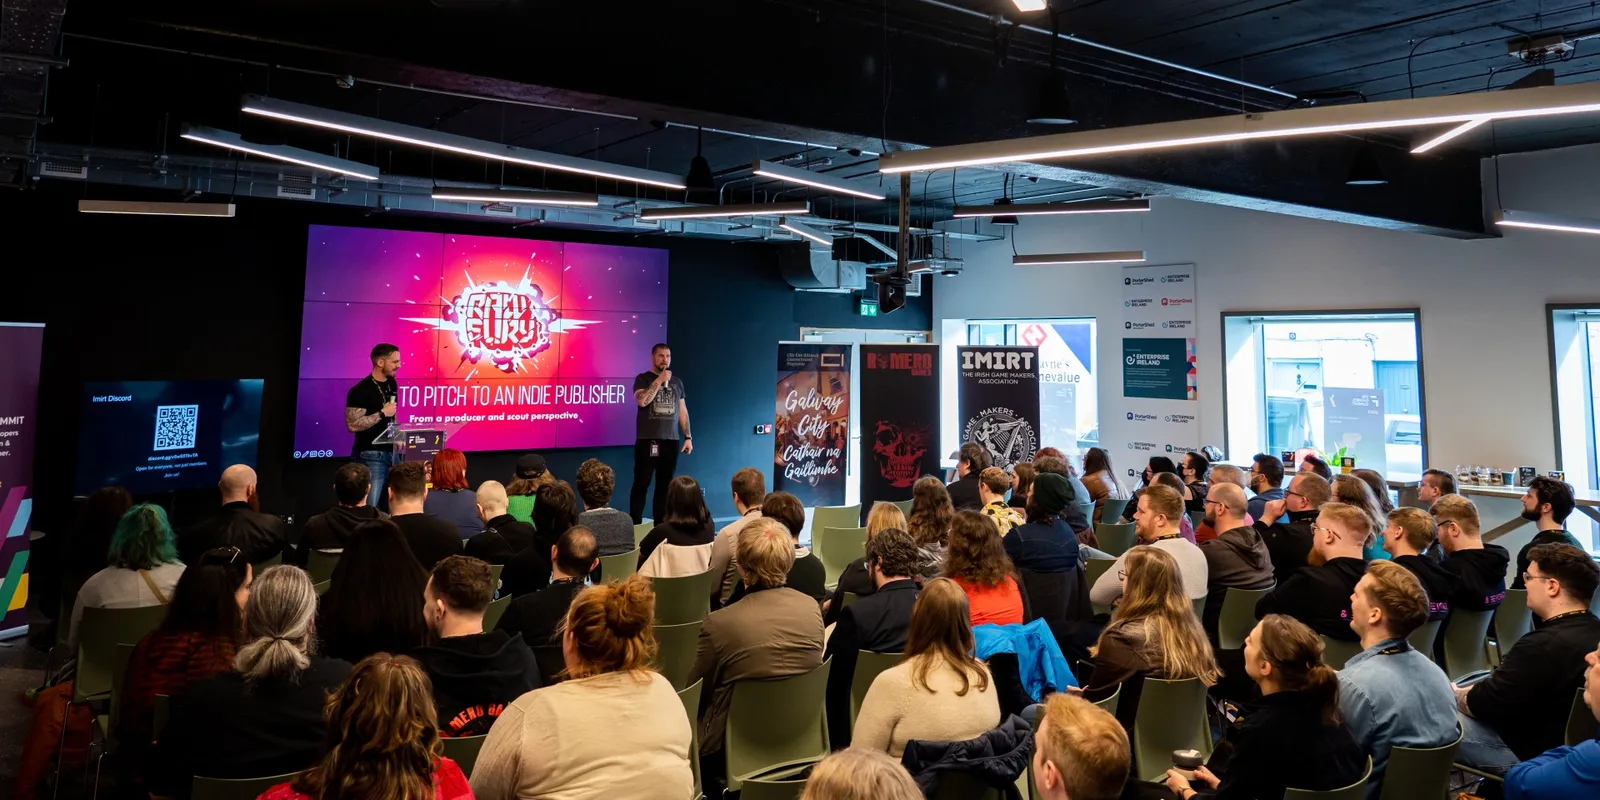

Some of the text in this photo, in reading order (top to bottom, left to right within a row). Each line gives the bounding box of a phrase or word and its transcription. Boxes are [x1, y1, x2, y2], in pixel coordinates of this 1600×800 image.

[467, 293, 527, 319] RAW
[961, 351, 1035, 370] IMIRT
[1040, 358, 1070, 369] ayne's
[399, 386, 420, 407] TO
[423, 386, 467, 407] PITCH
[471, 385, 490, 406] TO
[493, 385, 515, 405] AN
[518, 385, 552, 405] INDIE
[555, 384, 625, 405] PUBLISHER
[785, 387, 844, 415] Galway
[0, 416, 25, 425] MMIT
[409, 414, 434, 423] From
[445, 413, 485, 423] producer
[487, 413, 505, 421] and
[507, 412, 530, 421] scout
[531, 412, 579, 422] perspective
[797, 414, 830, 439] City
[0, 430, 19, 438] opers
[962, 407, 1037, 463] GAME MAKERS ASSOCIATIO
[783, 442, 842, 461] Cathair na
[784, 459, 839, 480] Gaillimhe
[448, 704, 504, 731] MERO GA
